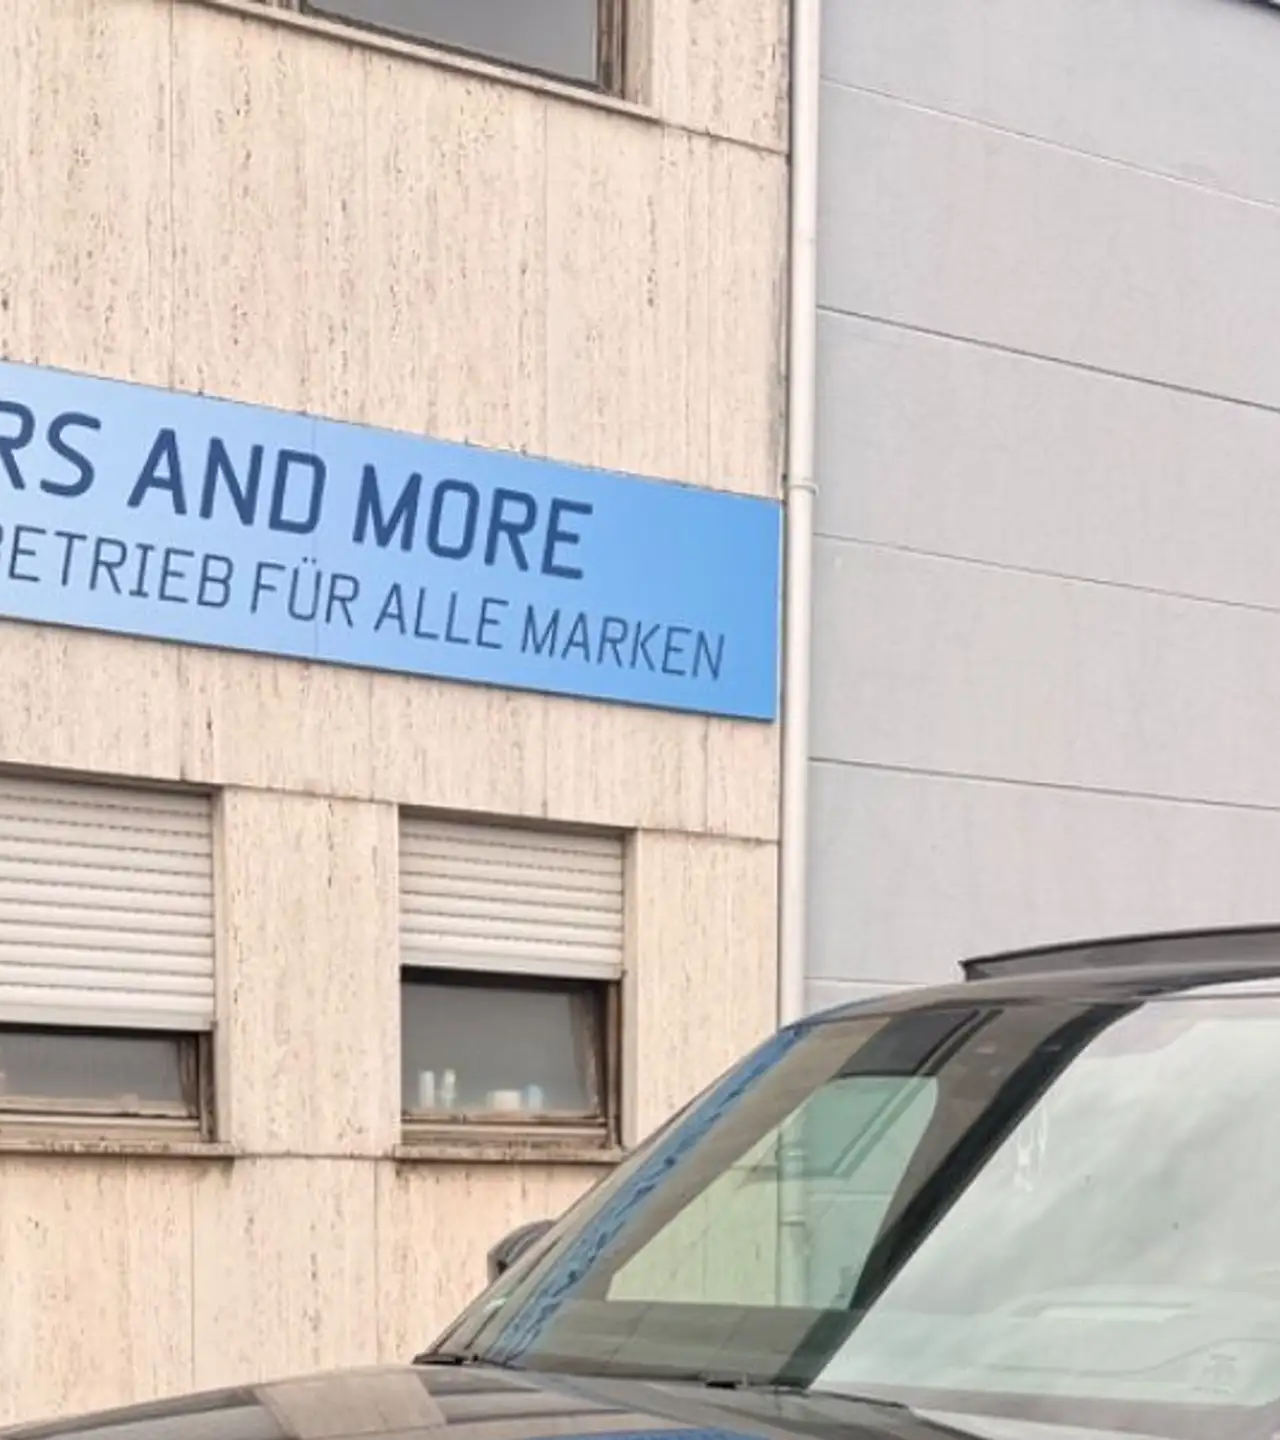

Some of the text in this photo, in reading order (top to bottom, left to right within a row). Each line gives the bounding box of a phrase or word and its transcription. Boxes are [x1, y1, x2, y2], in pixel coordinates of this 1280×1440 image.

[127, 428, 327, 535] AND
[352, 463, 593, 580] MORE
[249, 556, 361, 628] FÜR
[373, 583, 509, 651] ALLE
[520, 604, 725, 682] MARKEN
